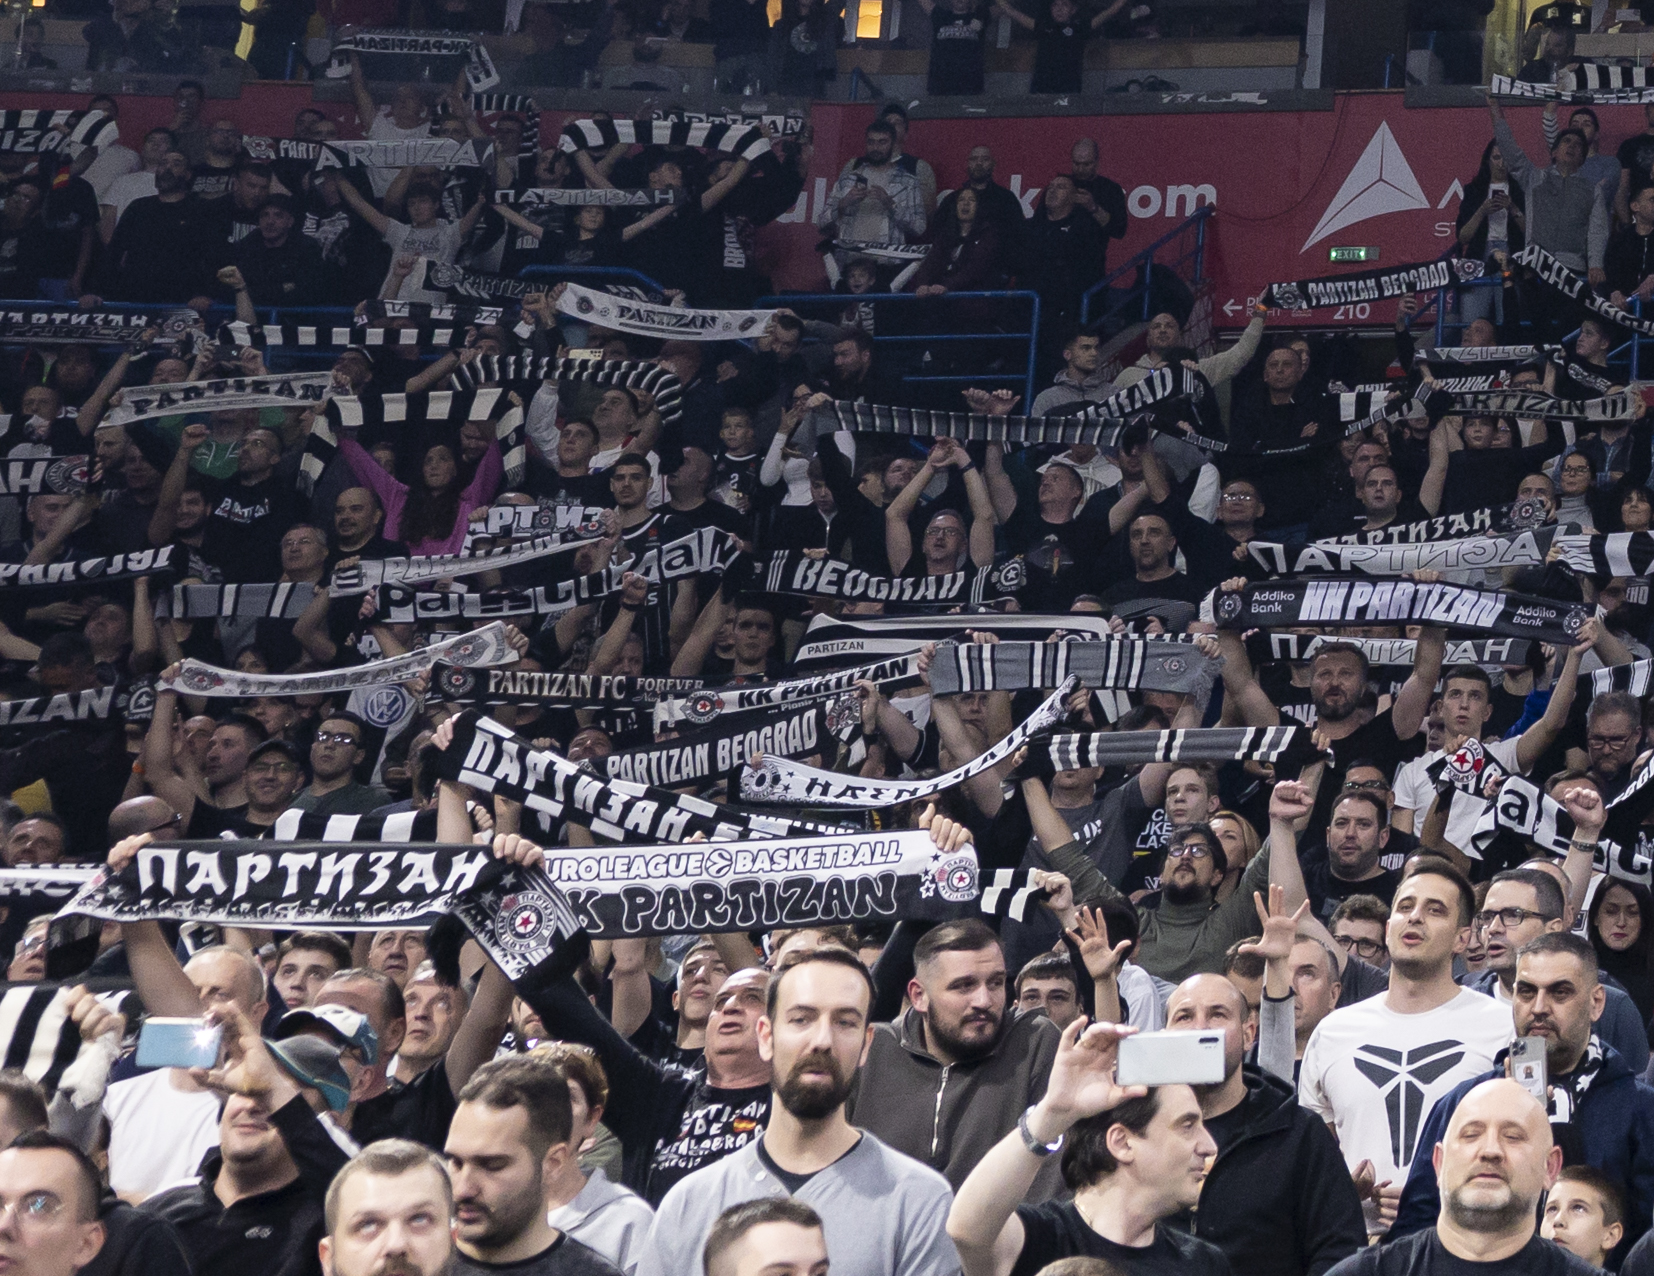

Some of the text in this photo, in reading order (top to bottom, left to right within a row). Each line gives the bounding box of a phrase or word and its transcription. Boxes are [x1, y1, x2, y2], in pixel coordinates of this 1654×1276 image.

[1336, 250, 1362, 260] EXIT
[1308, 278, 1381, 306] PARTIZAN
[617, 305, 719, 333] PARTIZAN
[1250, 590, 1296, 603] Addiko
[1250, 603, 1283, 615] Bank
[1351, 581, 1506, 627] PARTIZAN
[1512, 616, 1543, 630] Bank
[1515, 605, 1558, 620] Addiko
[806, 640, 865, 655] PARTIZAN
[488, 669, 593, 702] PARTIZAN
[597, 675, 626, 702] FC
[605, 736, 708, 786] PARTIZAN
[713, 717, 817, 771] BEOGRAD
[462, 732, 692, 844] ПАРТИЗАН
[137, 839, 489, 899] ПАРТИЗАН
[734, 838, 905, 875] BASKETBALL
[620, 870, 898, 934] PARTIZAN
